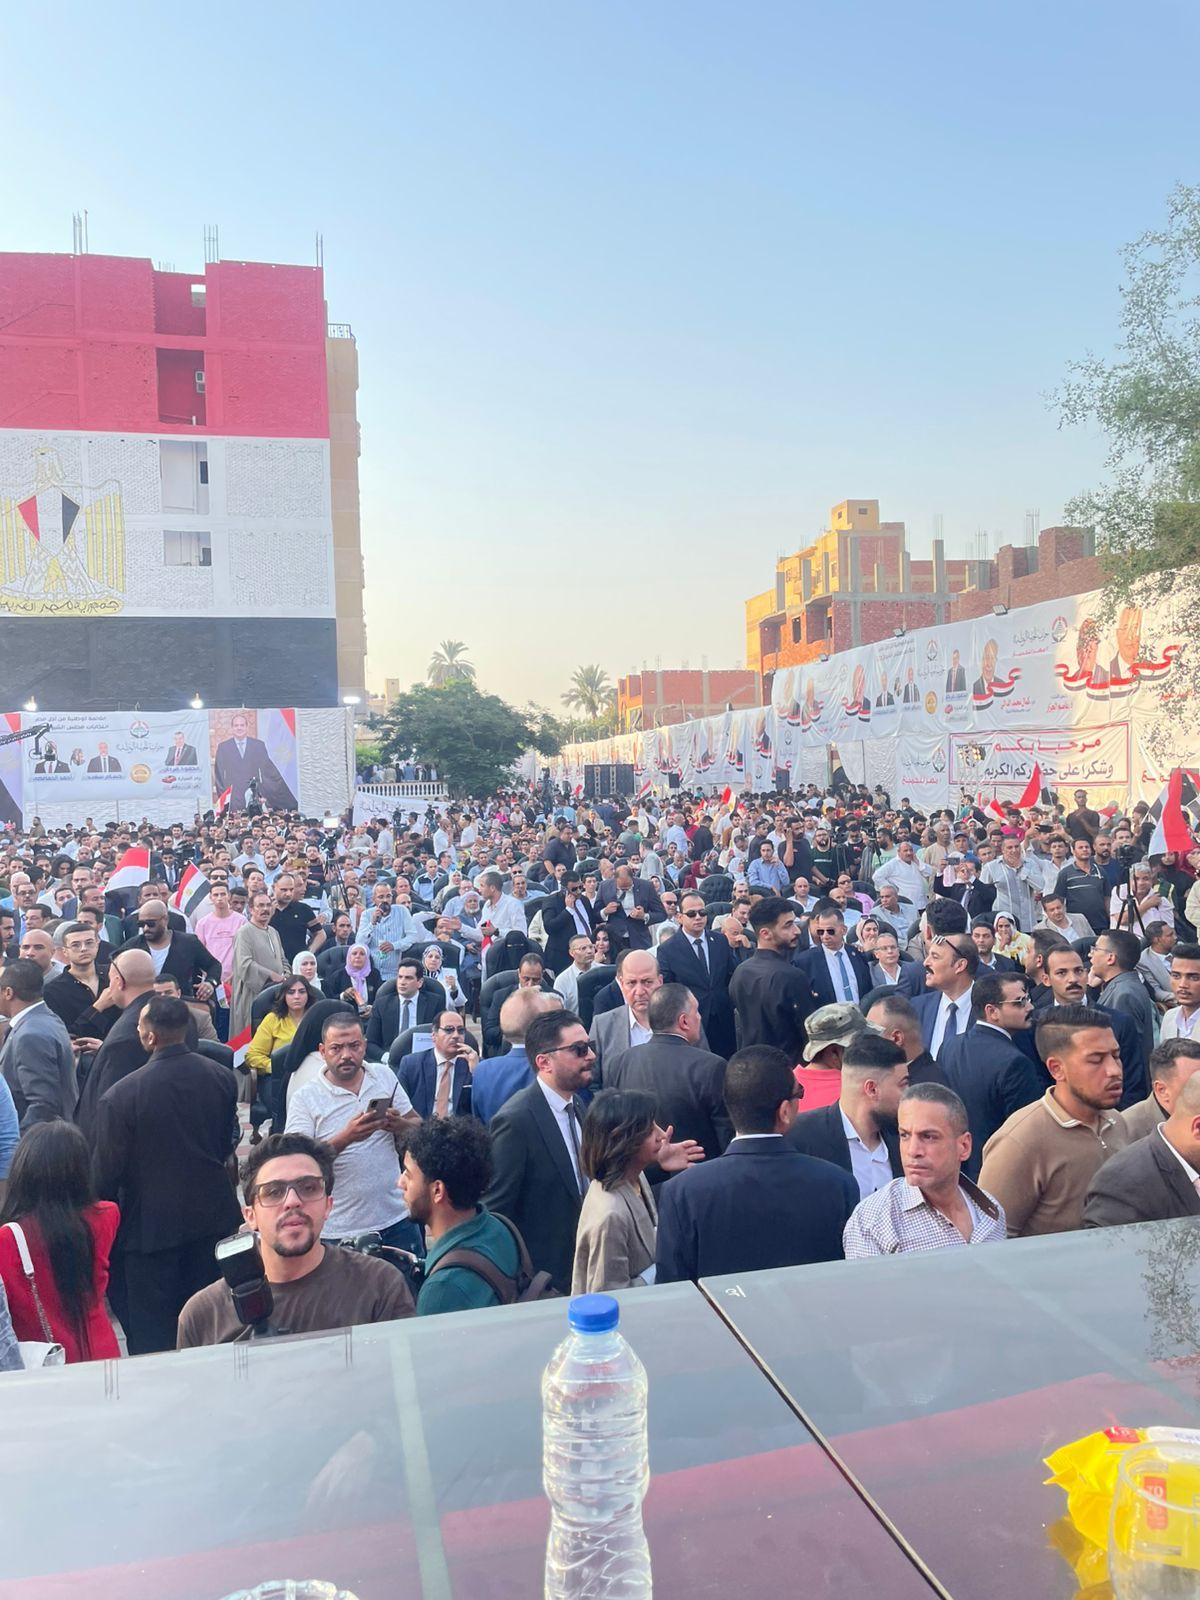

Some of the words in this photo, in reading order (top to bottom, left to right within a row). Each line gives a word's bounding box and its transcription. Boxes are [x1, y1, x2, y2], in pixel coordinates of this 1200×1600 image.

[993, 737, 1035, 756] بكم
[1037, 737, 1101, 755] مرحبا
[1058, 762, 1080, 780] على
